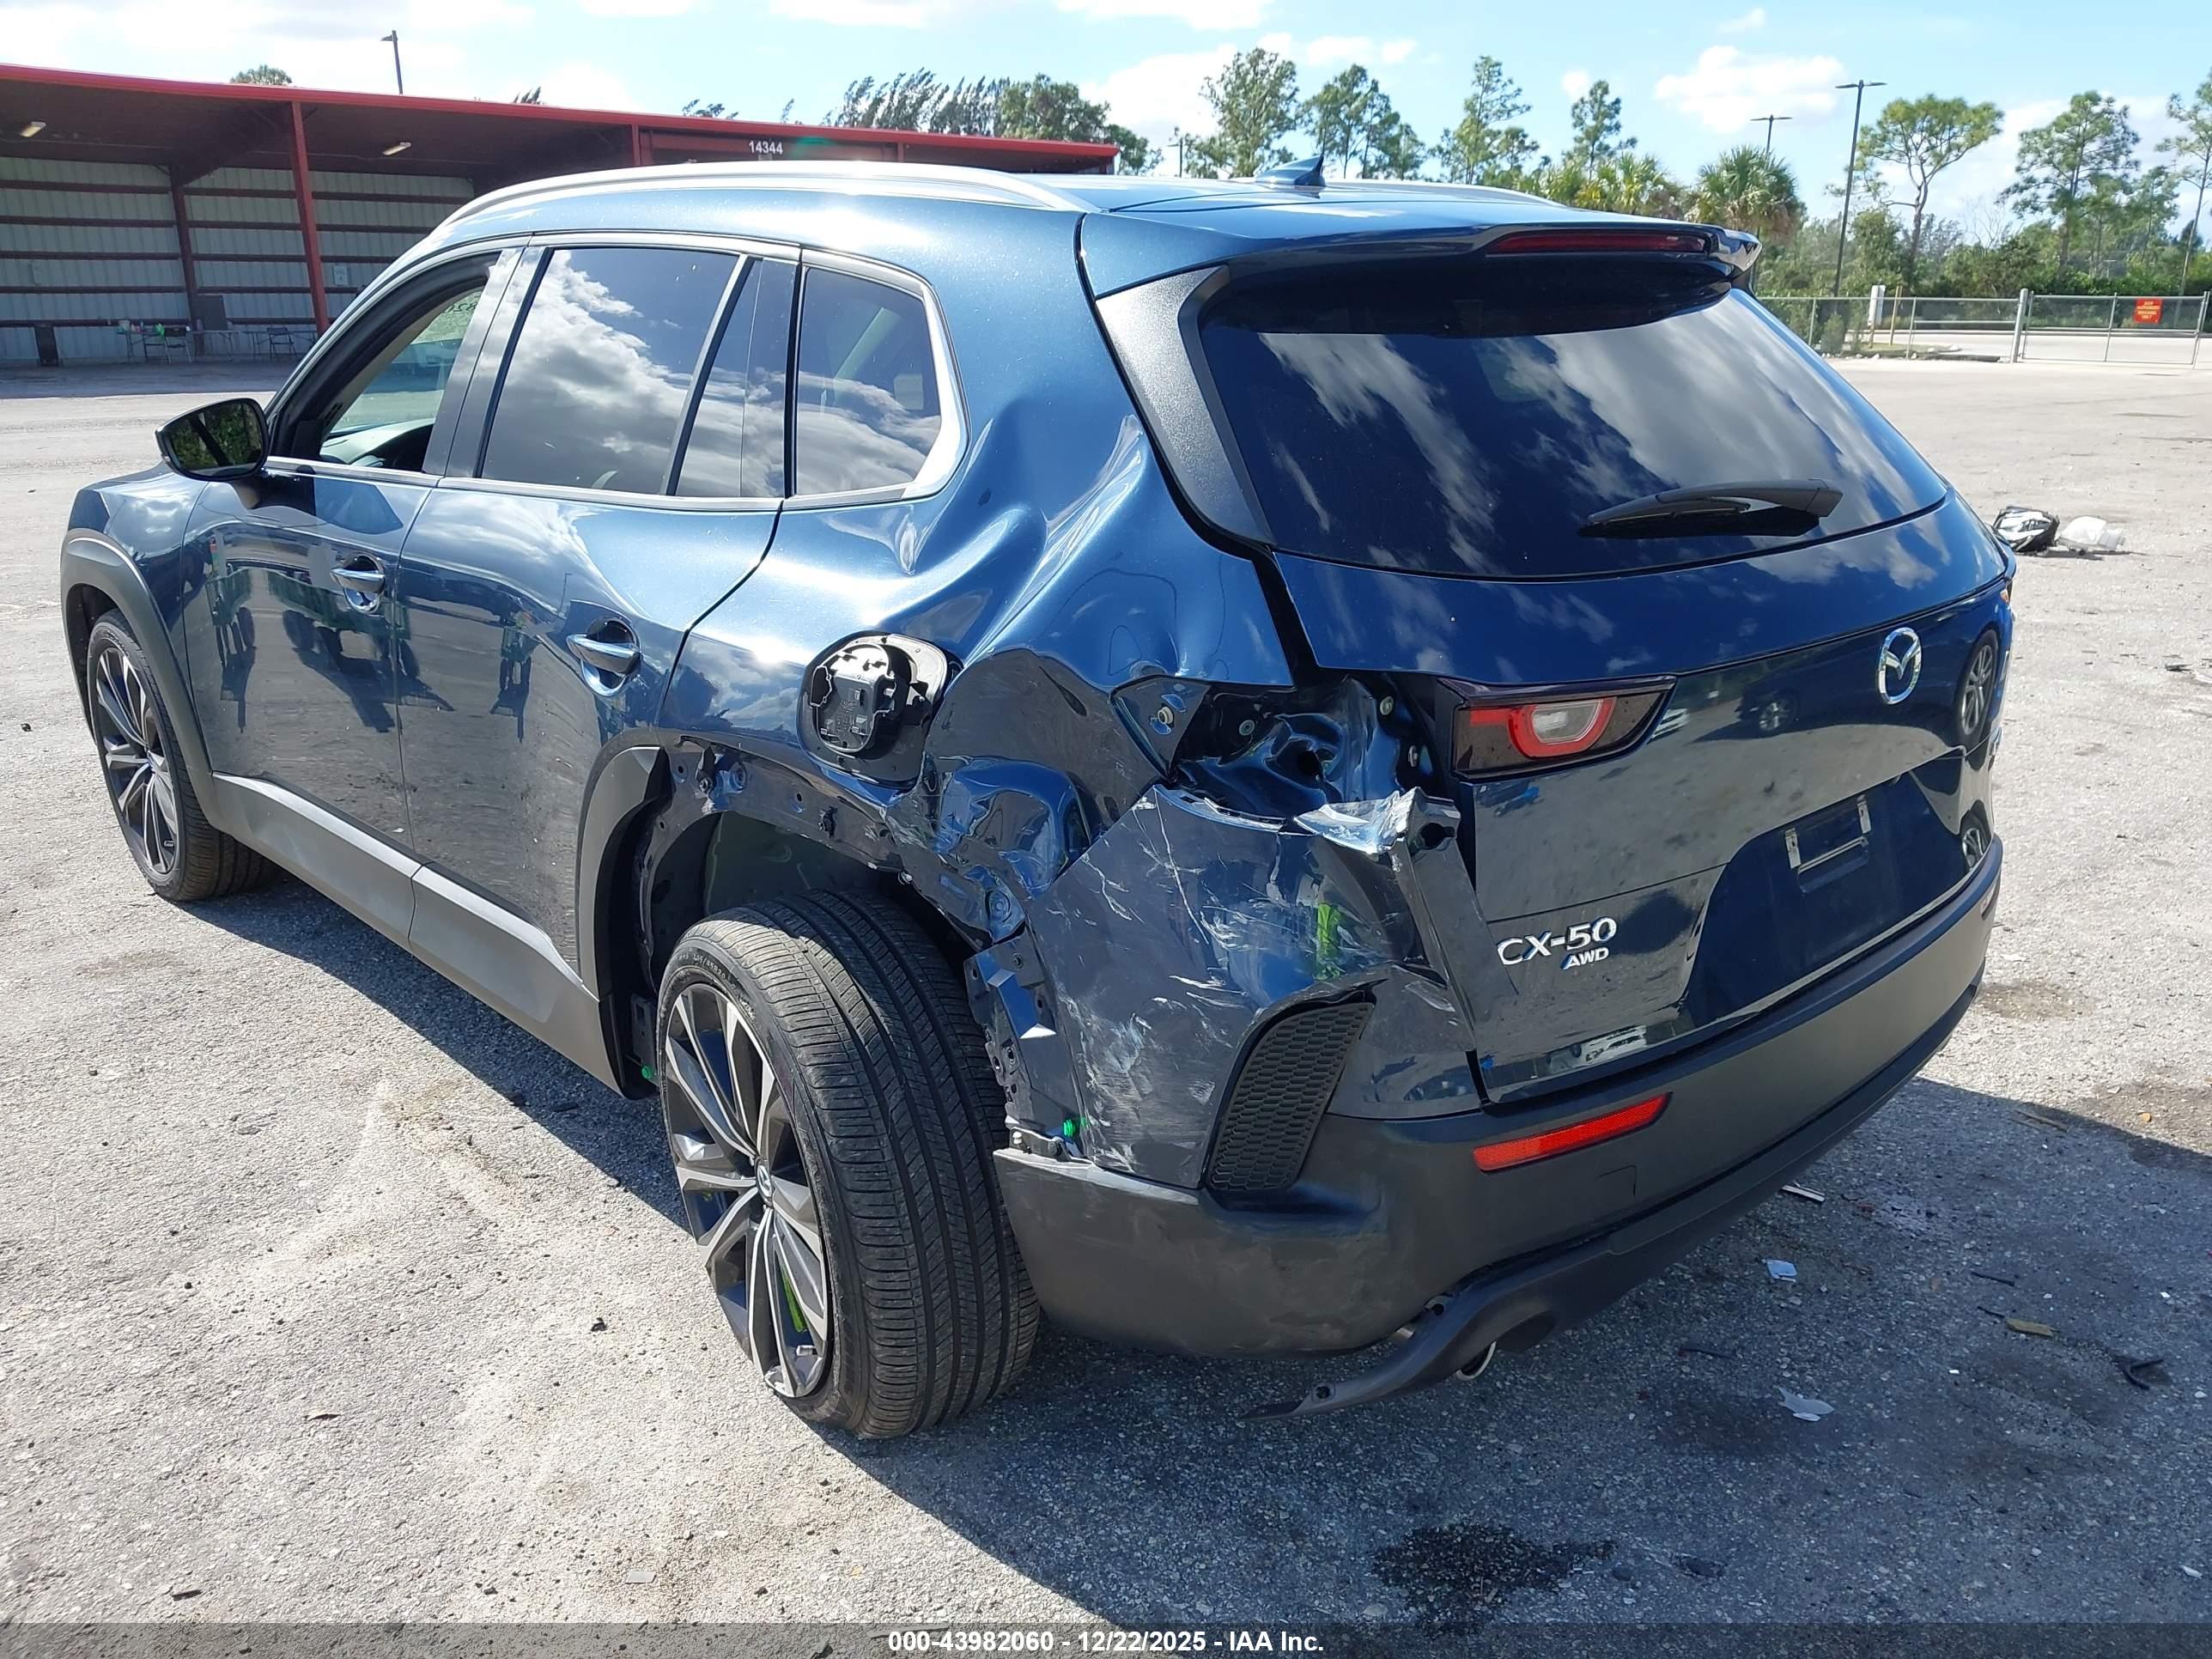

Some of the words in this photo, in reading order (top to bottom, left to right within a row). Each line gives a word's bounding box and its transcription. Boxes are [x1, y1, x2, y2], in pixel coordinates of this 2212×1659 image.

[748, 140, 783, 155] 14344
[1497, 916, 1617, 965] CX-50
[1560, 947, 1609, 970] AWD
